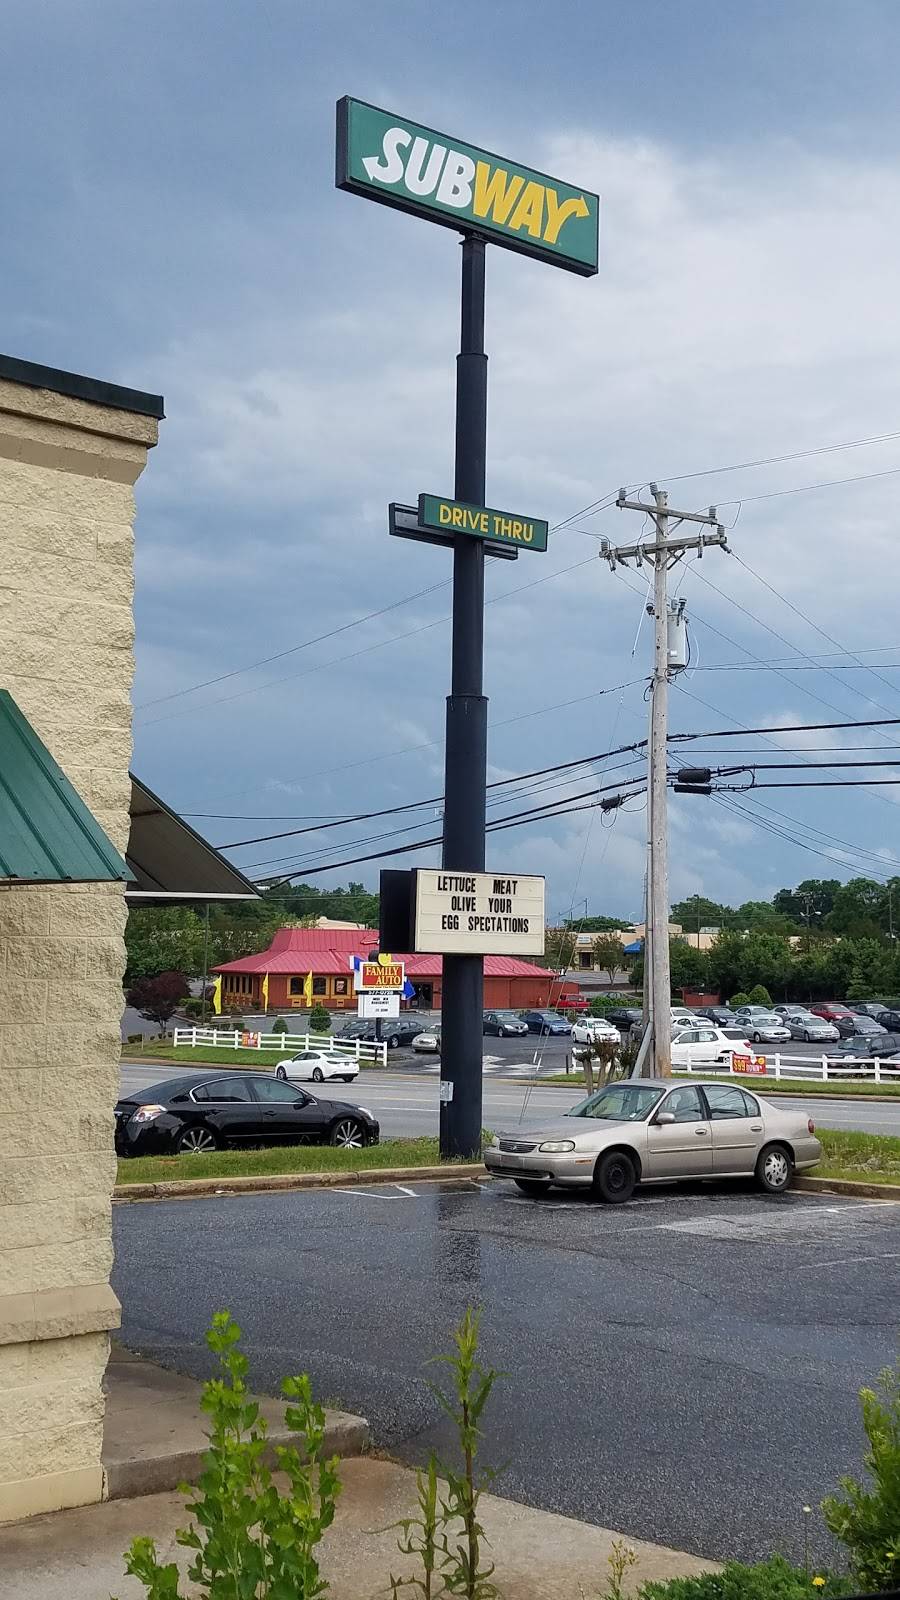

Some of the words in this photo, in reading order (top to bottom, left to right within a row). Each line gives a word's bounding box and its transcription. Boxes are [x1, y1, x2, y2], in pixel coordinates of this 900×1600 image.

[362, 127, 590, 244] SUBWAY
[439, 504, 489, 533] DRIVE
[493, 516, 534, 542] THRU
[437, 876, 476, 893] LETTUCE
[493, 879, 518, 895] MEAT
[451, 896, 476, 912] OLIVE
[488, 898, 512, 913] YOUR
[441, 915, 459, 930] EGG
[468, 916, 529, 933] SPECTATIONS
[365, 966, 399, 976] FAMILY
[375, 975, 401, 985] AUTO
